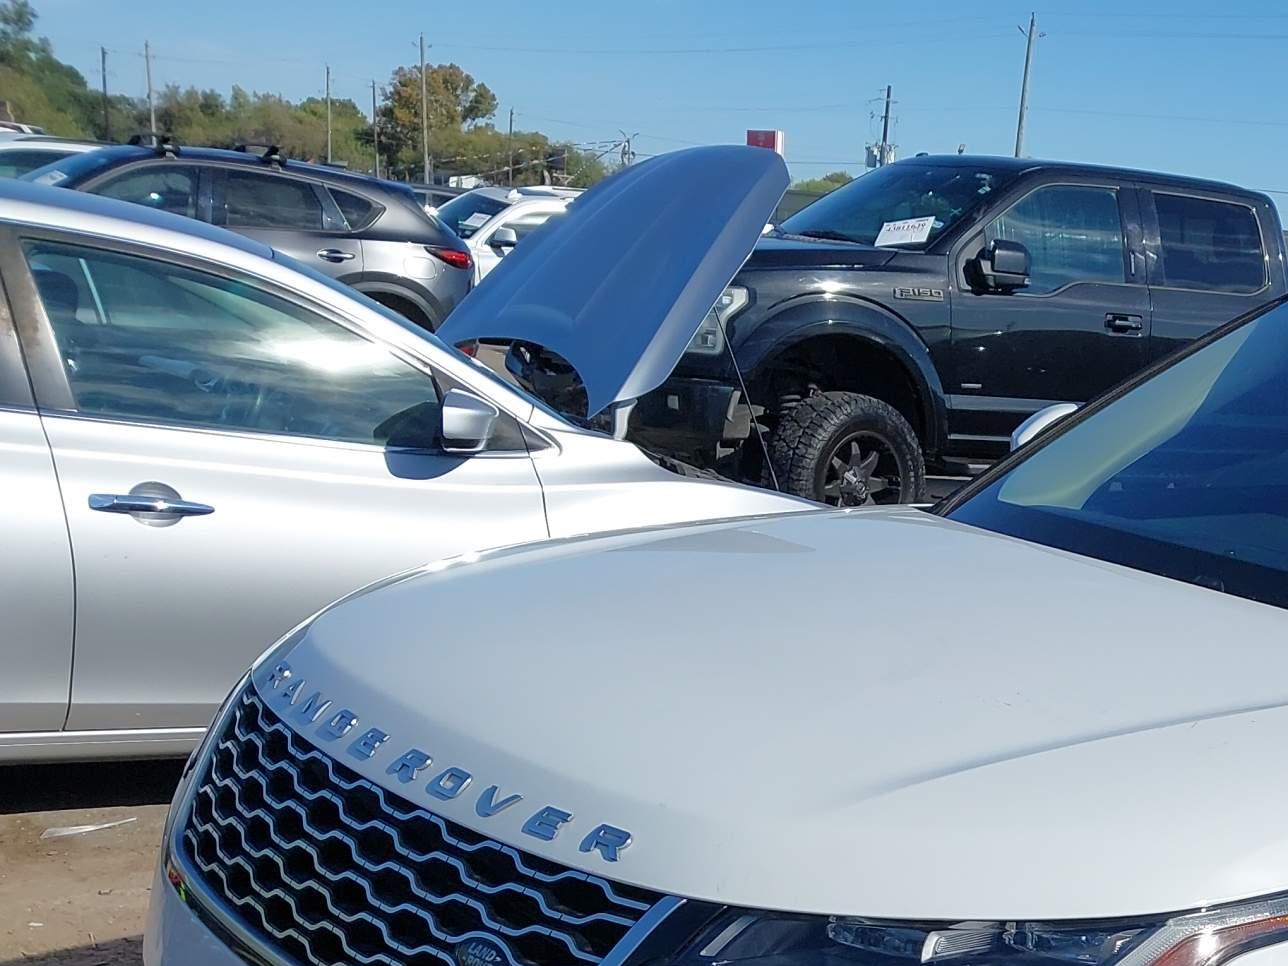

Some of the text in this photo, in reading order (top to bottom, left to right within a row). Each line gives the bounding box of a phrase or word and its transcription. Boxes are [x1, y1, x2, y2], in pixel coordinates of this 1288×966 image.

[269, 661, 634, 864] RANGE ROVER
[468, 942, 497, 962] LAND
